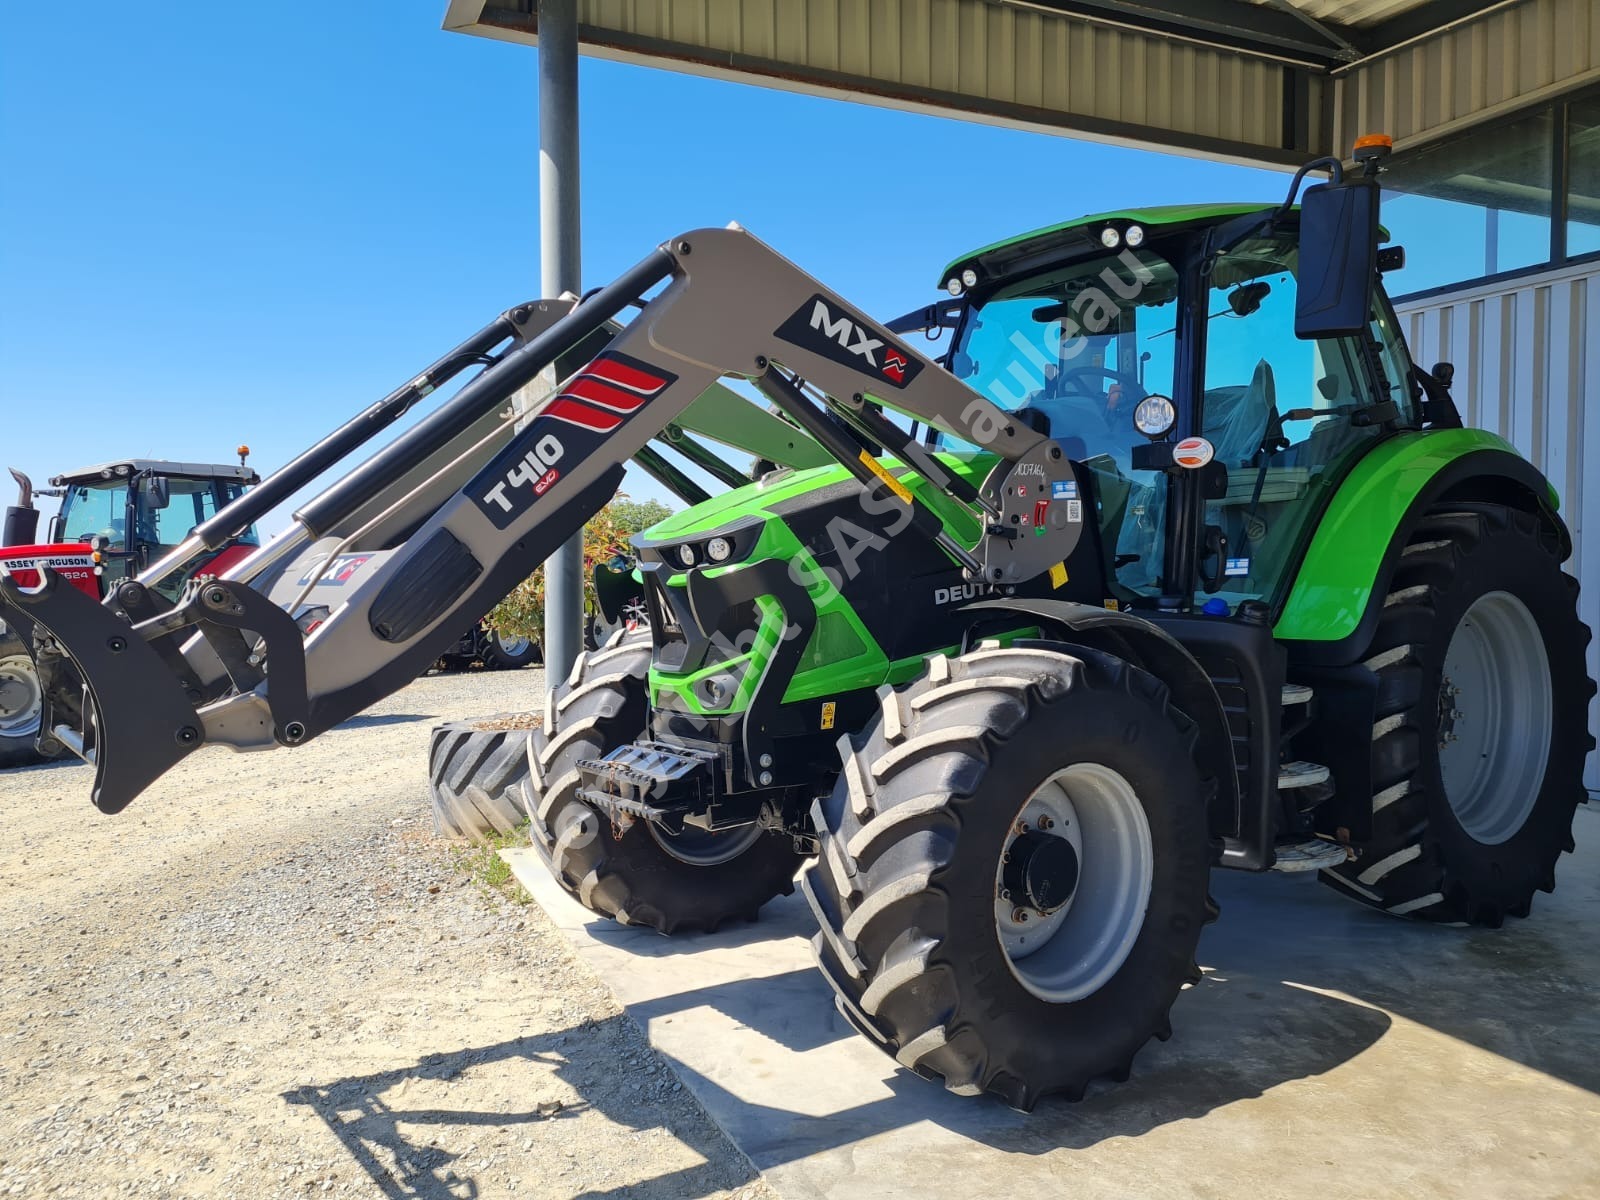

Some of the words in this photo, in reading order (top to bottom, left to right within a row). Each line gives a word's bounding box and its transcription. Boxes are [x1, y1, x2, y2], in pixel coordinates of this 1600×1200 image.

[809, 300, 885, 368] MX
[483, 434, 564, 513] T410
[535, 470, 556, 493] EVO
[934, 583, 984, 605] DEUT
